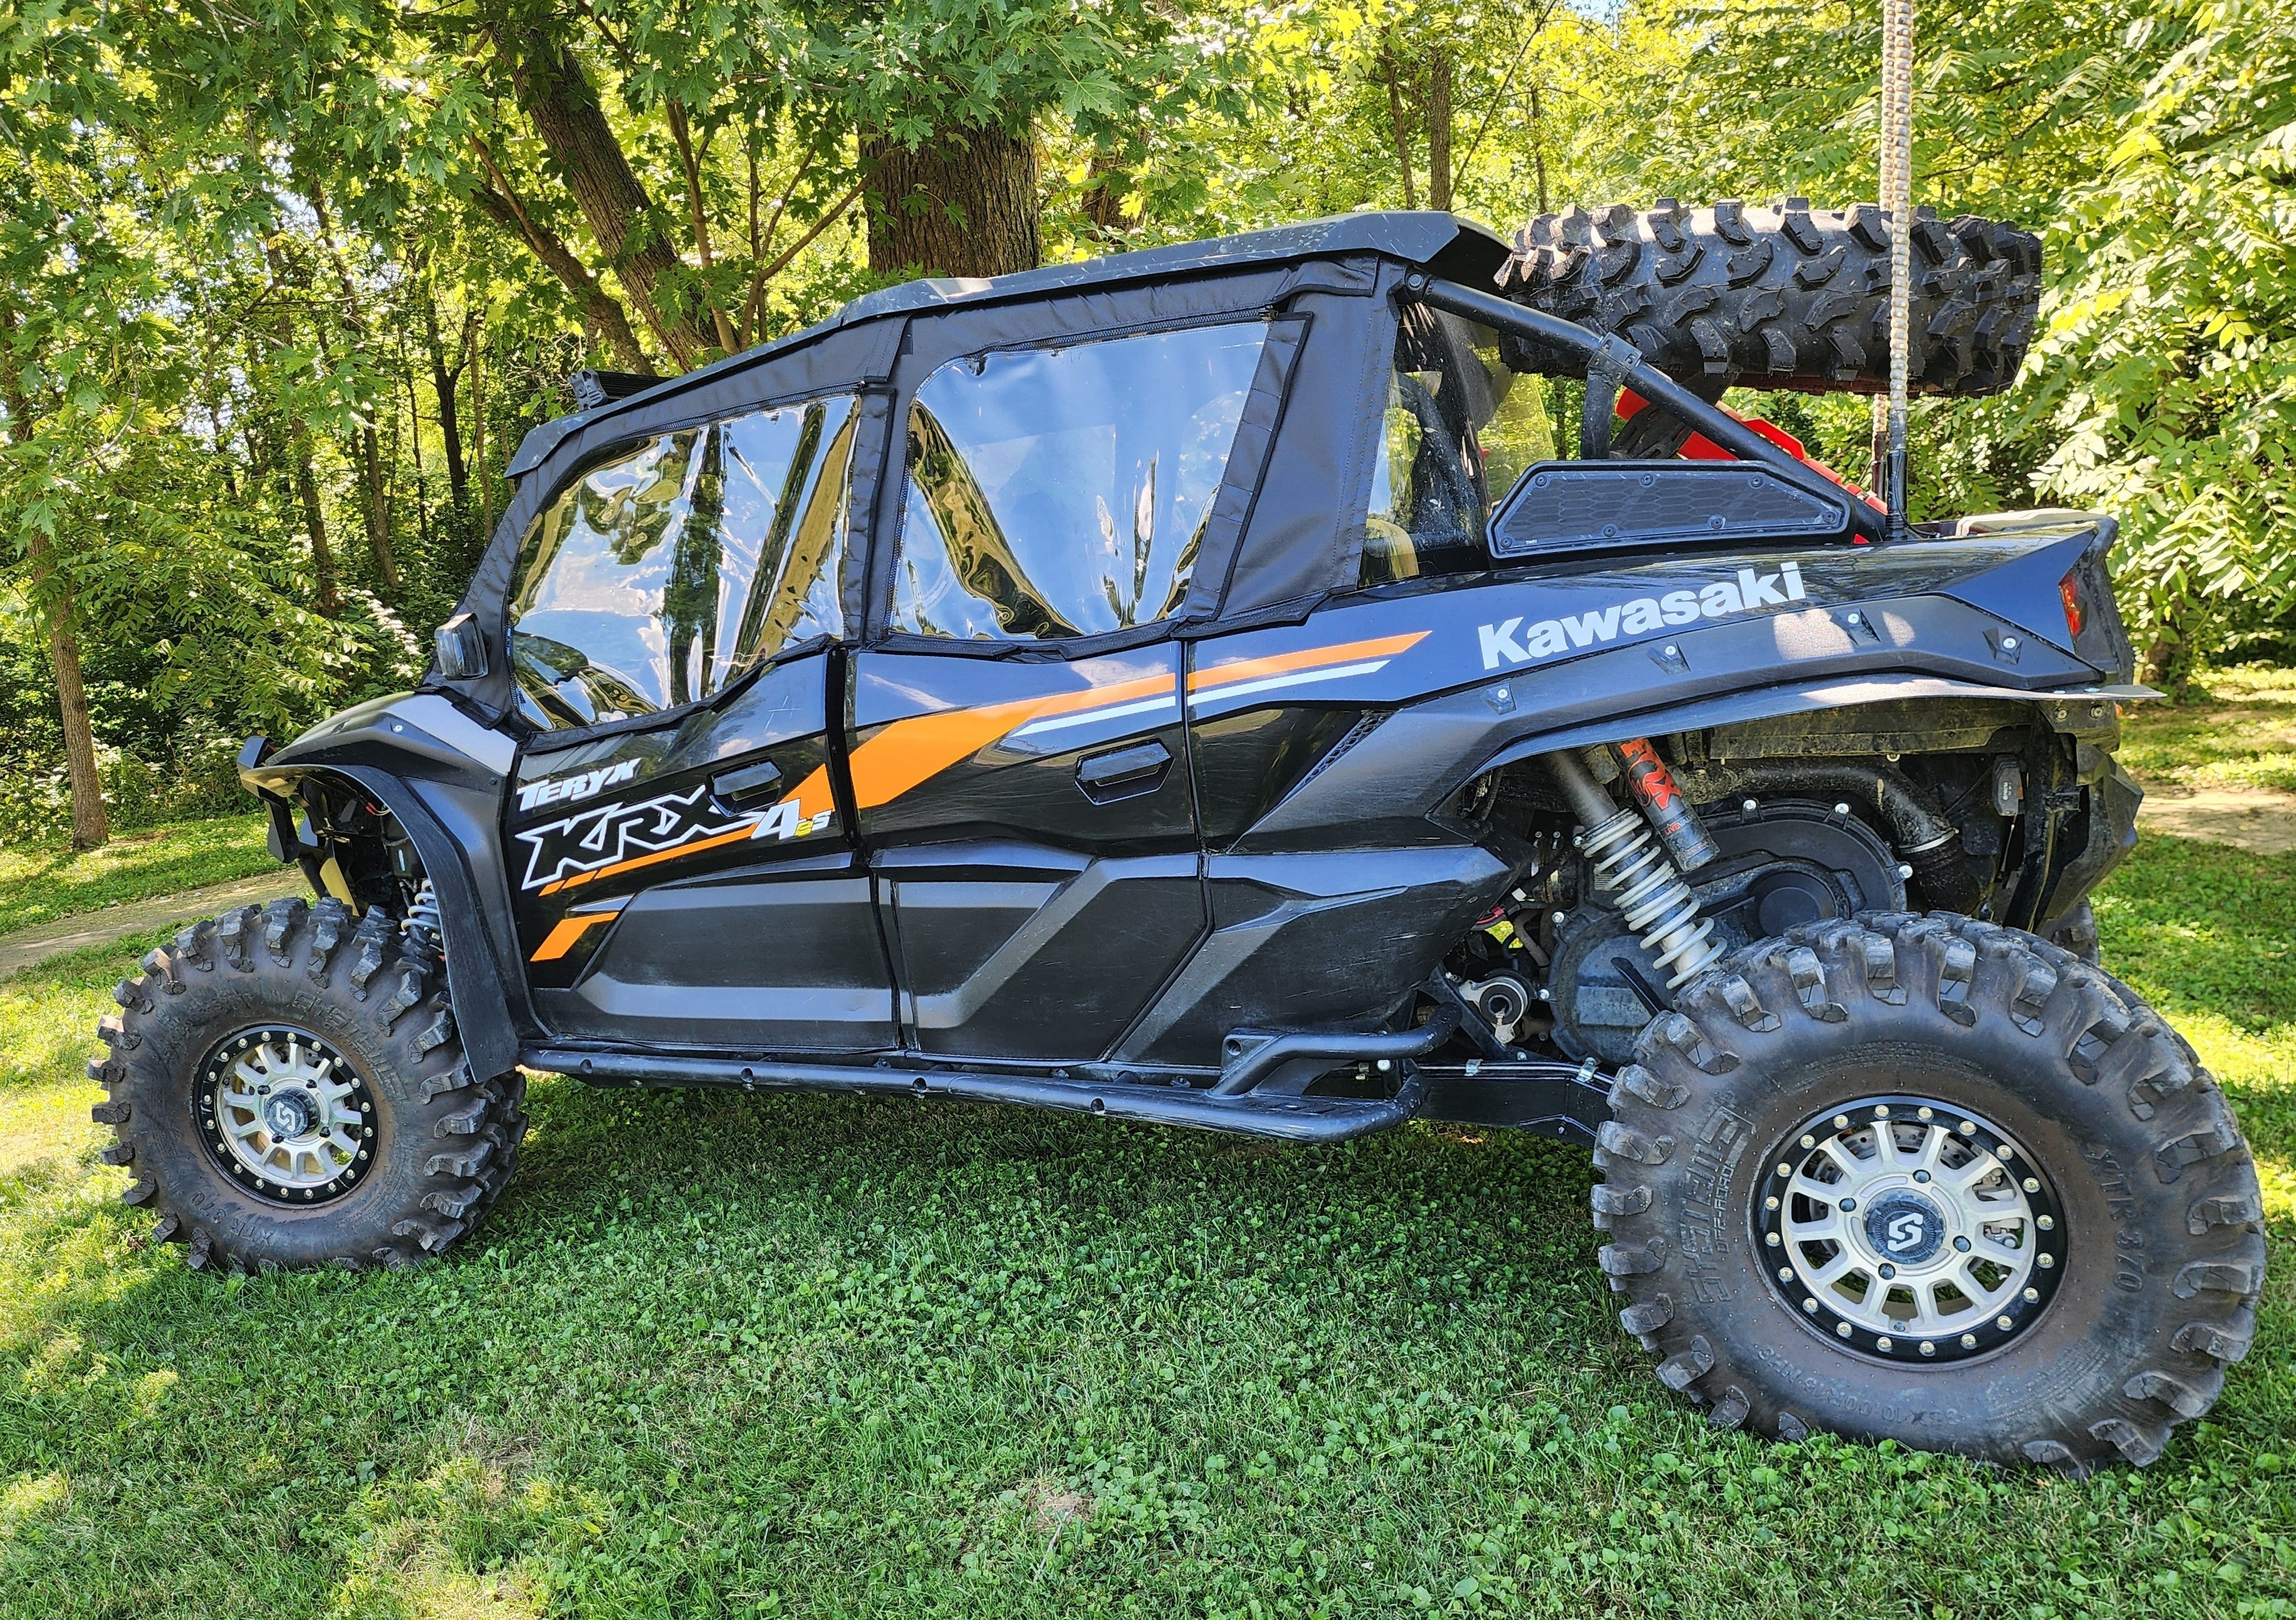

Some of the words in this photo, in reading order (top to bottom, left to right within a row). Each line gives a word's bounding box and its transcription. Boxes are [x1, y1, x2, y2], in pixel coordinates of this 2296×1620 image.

[1478, 561, 1807, 671] Kawasaki
[516, 758, 641, 812] TERYX
[2114, 1230, 2147, 1292] 370
